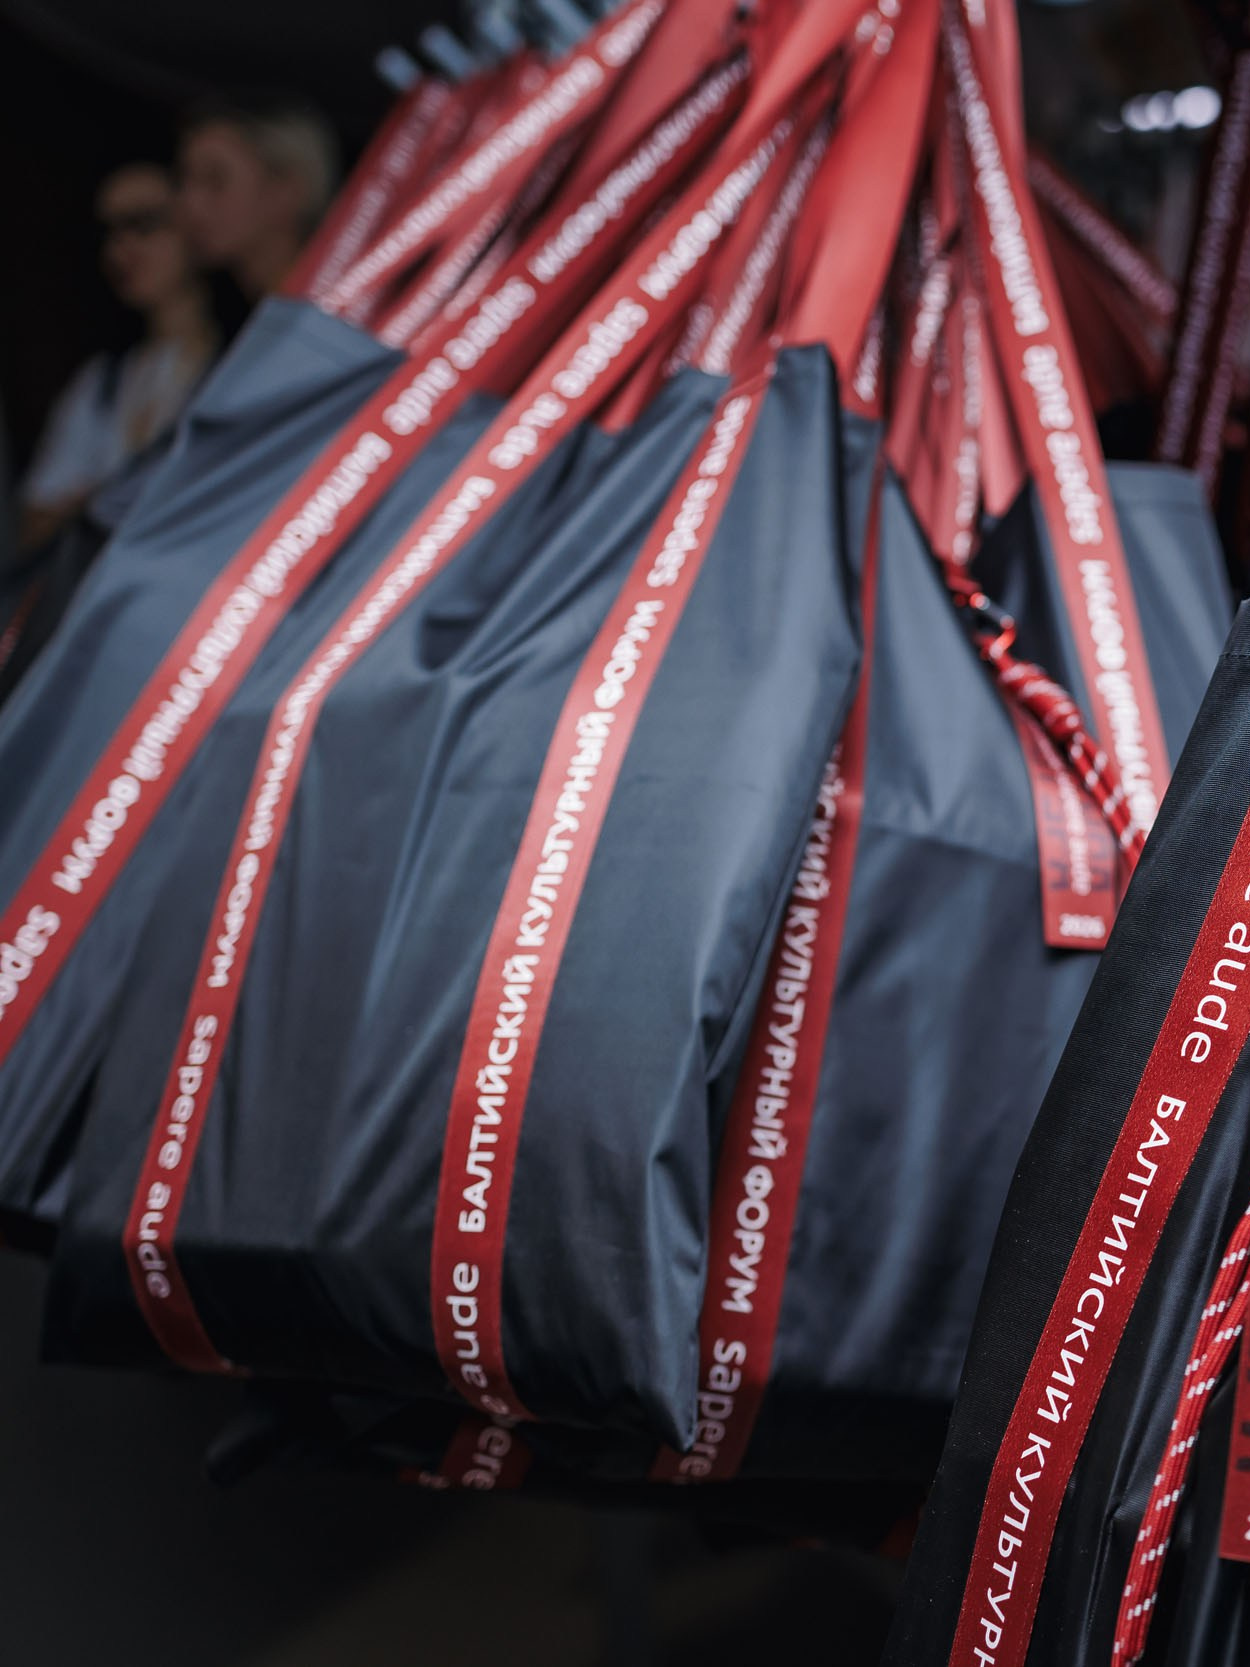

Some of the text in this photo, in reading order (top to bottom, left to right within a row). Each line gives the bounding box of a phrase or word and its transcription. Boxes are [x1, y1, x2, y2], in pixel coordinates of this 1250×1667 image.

[488, 394, 566, 469] aude
[244, 433, 390, 602] БАЛТИЙСКИЙ
[647, 479, 717, 587] sapere
[125, 586, 264, 779] КУЛЬТУРНЫЙ
[594, 601, 662, 709] ФОРУМ
[54, 775, 140, 893] ФОРУМ
[517, 712, 614, 946] КУЛЬТУРНЫЙ
[208, 853, 259, 987] ФОРУМ
[157, 1013, 218, 1170] sapere
[458, 954, 540, 1233] БАЛТИЙСКИЙ
[749, 907, 819, 1160] КУЛЬТУРНЫЙ
[136, 1180, 172, 1299] aude
[723, 1165, 773, 1313] ФОРУМ
[1037, 1095, 1184, 1423] БАЛТИЙСКИЙ
[445, 1262, 488, 1388] aude
[679, 1336, 747, 1478] sapere
